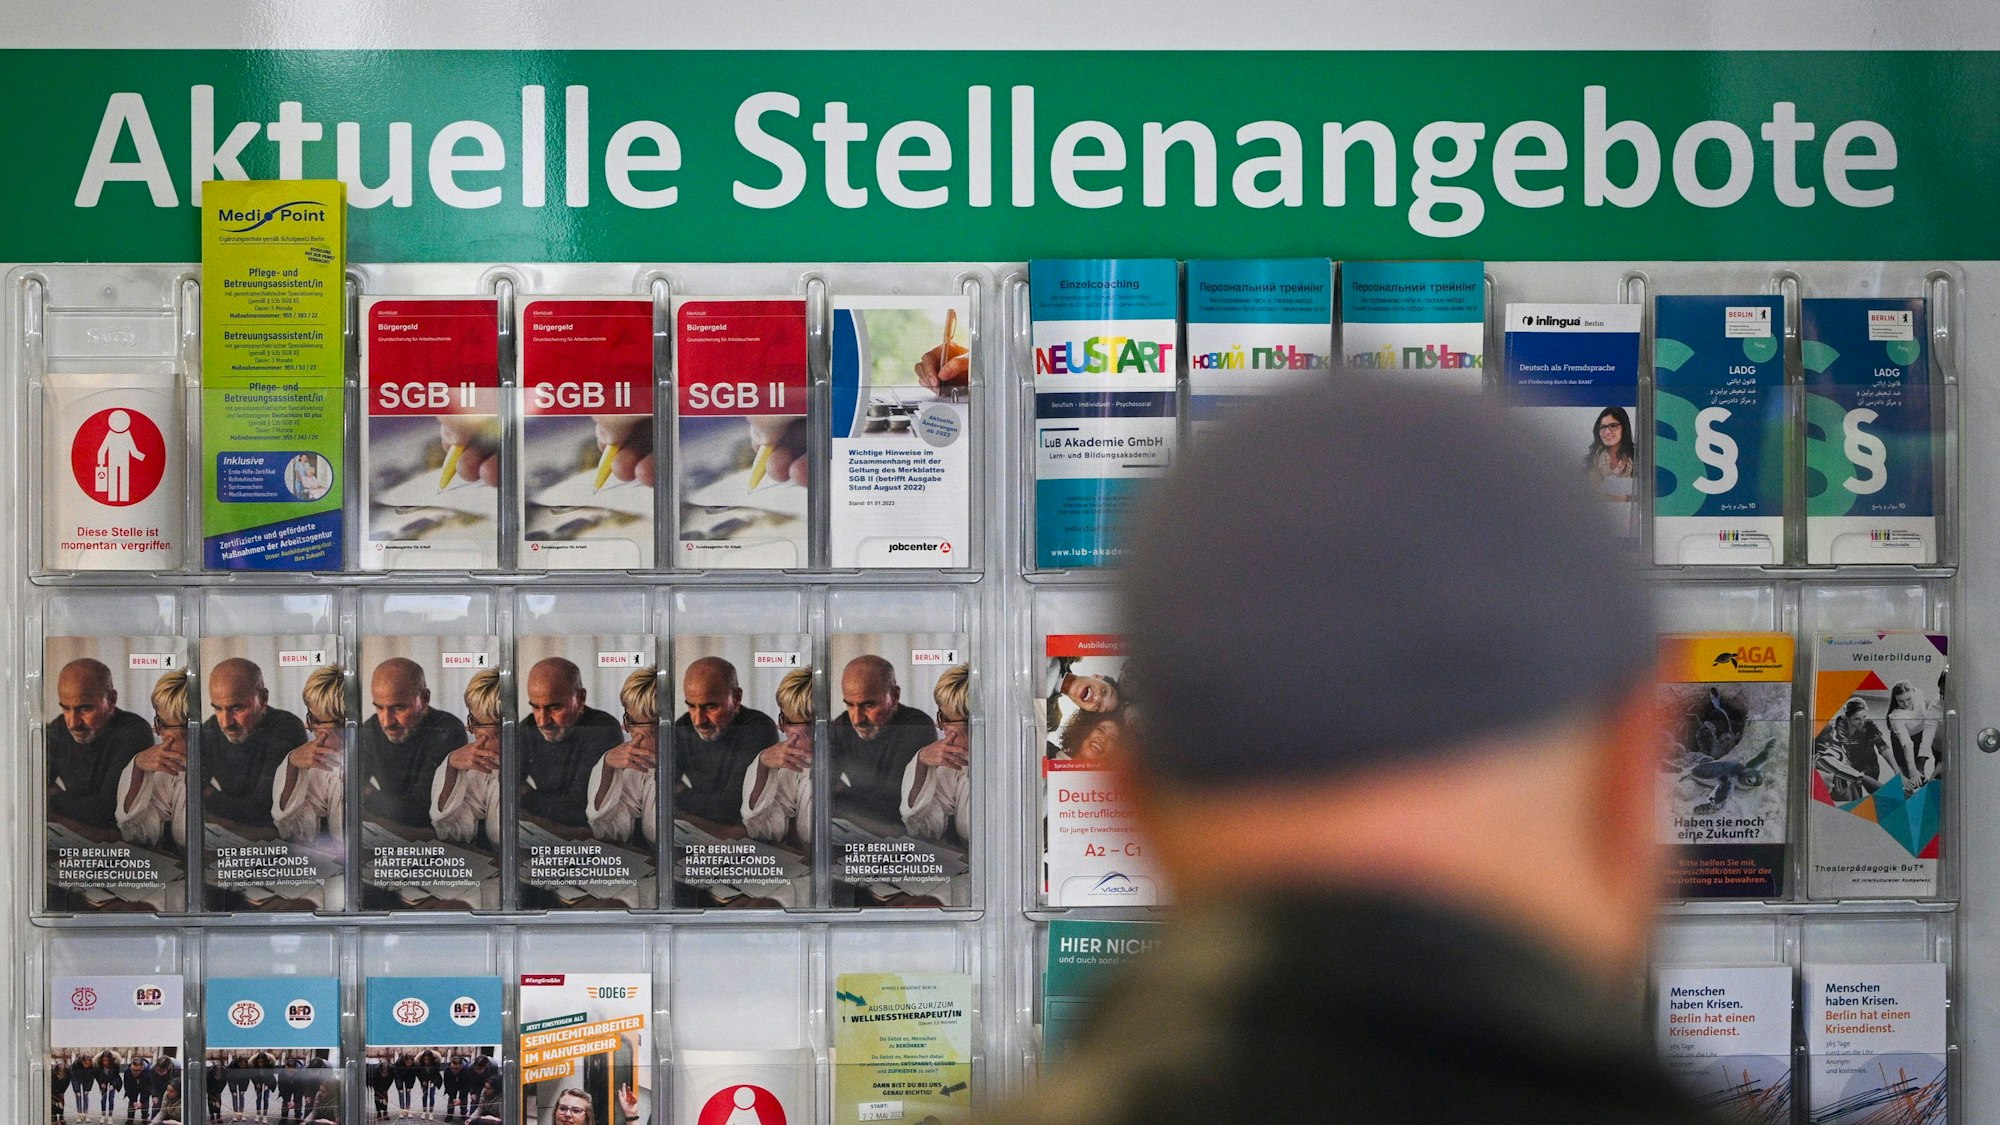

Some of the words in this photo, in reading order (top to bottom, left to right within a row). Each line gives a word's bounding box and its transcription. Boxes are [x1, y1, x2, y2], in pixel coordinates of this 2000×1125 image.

[74, 85, 681, 208] Aktuelle
[733, 85, 1898, 237] Stellenangebote
[219, 210, 260, 221] Medi
[281, 210, 325, 221] Point
[249, 268, 280, 278] Pflege-
[283, 268, 298, 276] und
[224, 279, 323, 289] Betreuungsassistent/in
[1060, 280, 1140, 290] Einzelcoaching
[1200, 282, 1276, 293] Персональний
[1280, 282, 1324, 293] трейнінг
[1352, 282, 1425, 292] Персональний
[1430, 282, 1476, 292] трейнінг
[378, 323, 418, 332] Bürgergeld
[533, 323, 573, 332] Bürgergeld
[687, 324, 727, 332] Bürgergeld
[224, 331, 323, 341] Betreuungsassistent/in
[1036, 337, 1173, 374] NEUSTART
[1563, 364, 1616, 372] Fremdsprache
[1729, 366, 1756, 374] LADG
[1874, 368, 1900, 377] LADG
[249, 383, 281, 392] Pflege-
[283, 383, 298, 391] und
[224, 394, 323, 404] Betreuungsassistent/in
[379, 382, 450, 408] SGB
[460, 382, 475, 407] II
[534, 382, 605, 408] SGB
[615, 382, 630, 407] II
[688, 382, 759, 409] SGB
[770, 382, 785, 408] II
[1045, 438, 1061, 448] LuB
[1065, 437, 1124, 448] Akademie
[1128, 437, 1163, 447] GmbH
[223, 457, 264, 465] Inklusive
[848, 458, 911, 466] Zusammenhang
[875, 475, 906, 483] (betrifft
[874, 484, 901, 492] August
[903, 484, 925, 492] 2022)
[77, 526, 109, 537] Diese
[111, 526, 144, 537] Stelle
[146, 526, 159, 537] ist
[219, 535, 262, 549] Zertifizierte
[264, 532, 277, 540] und
[279, 523, 316, 538] geförderte
[61, 540, 118, 551] momentan
[121, 540, 172, 552] vergriffen.
[222, 546, 265, 560] Maßnahmen
[267, 542, 278, 551] der
[280, 530, 333, 548] Arbeitsagentur
[889, 542, 937, 552] jobcenter
[282, 655, 308, 663] BERLIN
[1737, 646, 1776, 663] AGA
[1852, 653, 1932, 663] Weiterbildung
[601, 656, 626, 664] BERLIN
[1674, 817, 1713, 827] Haben
[1716, 817, 1732, 827] sie
[1735, 817, 1764, 827] noch
[1678, 829, 1703, 839] eine
[1706, 828, 1760, 839] Zukunft?
[217, 848, 237, 857] DER
[239, 846, 288, 856] BERLINER
[374, 847, 394, 856] DER
[396, 847, 445, 856] BERLINER
[531, 846, 551, 856] DER
[553, 846, 602, 855] BERLINER
[685, 845, 705, 854] DER
[707, 845, 756, 854] BERLINER
[845, 844, 865, 852] DER
[867, 843, 915, 852] BERLINER
[1085, 843, 1106, 856] A2
[1124, 842, 1141, 856] C1
[59, 849, 79, 857] DER
[81, 849, 130, 857] BERLINER
[845, 852, 936, 863] HÄRTEFALLFONDS
[59, 857, 150, 869] HÄRTEFALLFONDS
[217, 855, 308, 868] HÄRTEFALLFONDS
[374, 856, 465, 867] HÄRTEFALLFONDS
[531, 856, 622, 866] HÄRTEFALLFONDS
[685, 854, 776, 865] HÄRTEFALLFONDS
[217, 867, 316, 879] ENERGIESCHULDEN
[374, 868, 473, 878] ENERGIESCHULDEN
[531, 868, 630, 877] ENERGIESCHULDEN
[685, 867, 784, 876] ENERGIESCHULDEN
[845, 865, 943, 874] ENERGIESCHULDEN
[1815, 864, 1897, 874] Theaterpädagogik
[59, 870, 158, 880] ENERGIESCHULDEN
[1060, 937, 1101, 953] HIER
[599, 987, 626, 999] ODEG
[1671, 987, 1725, 997] Menschen
[1825, 983, 1880, 993] Menschen
[137, 988, 161, 1000] BFD
[1670, 1000, 1704, 1009] haben
[1707, 999, 1743, 1009] Krisen.
[1826, 996, 1859, 1006] haben
[1862, 996, 1898, 1006] Krisen.
[289, 1006, 311, 1015] BFD
[454, 1003, 476, 1013] BFD
[868, 1002, 917, 1012] AUSBILDUNG
[918, 1001, 954, 1009] ZUR/ZUM
[851, 1010, 962, 1022] WELLNESSTHERAPEUT/IN
[1670, 1013, 1701, 1023] Berlin
[1705, 1013, 1721, 1022] hat
[1724, 1013, 1755, 1022] einen
[1825, 1010, 1857, 1020] Berlin
[1860, 1010, 1877, 1020] hat
[1879, 1010, 1910, 1019] einen
[525, 1017, 640, 1047] SERVICEMITARBEITER
[1669, 1026, 1739, 1036] Krisendienst.
[1825, 1024, 1895, 1033] Krisendienst.
[525, 1054, 538, 1064] IM
[543, 1038, 616, 1061] NAHVERKEHR
[525, 1062, 570, 1082] (M/W/D)
